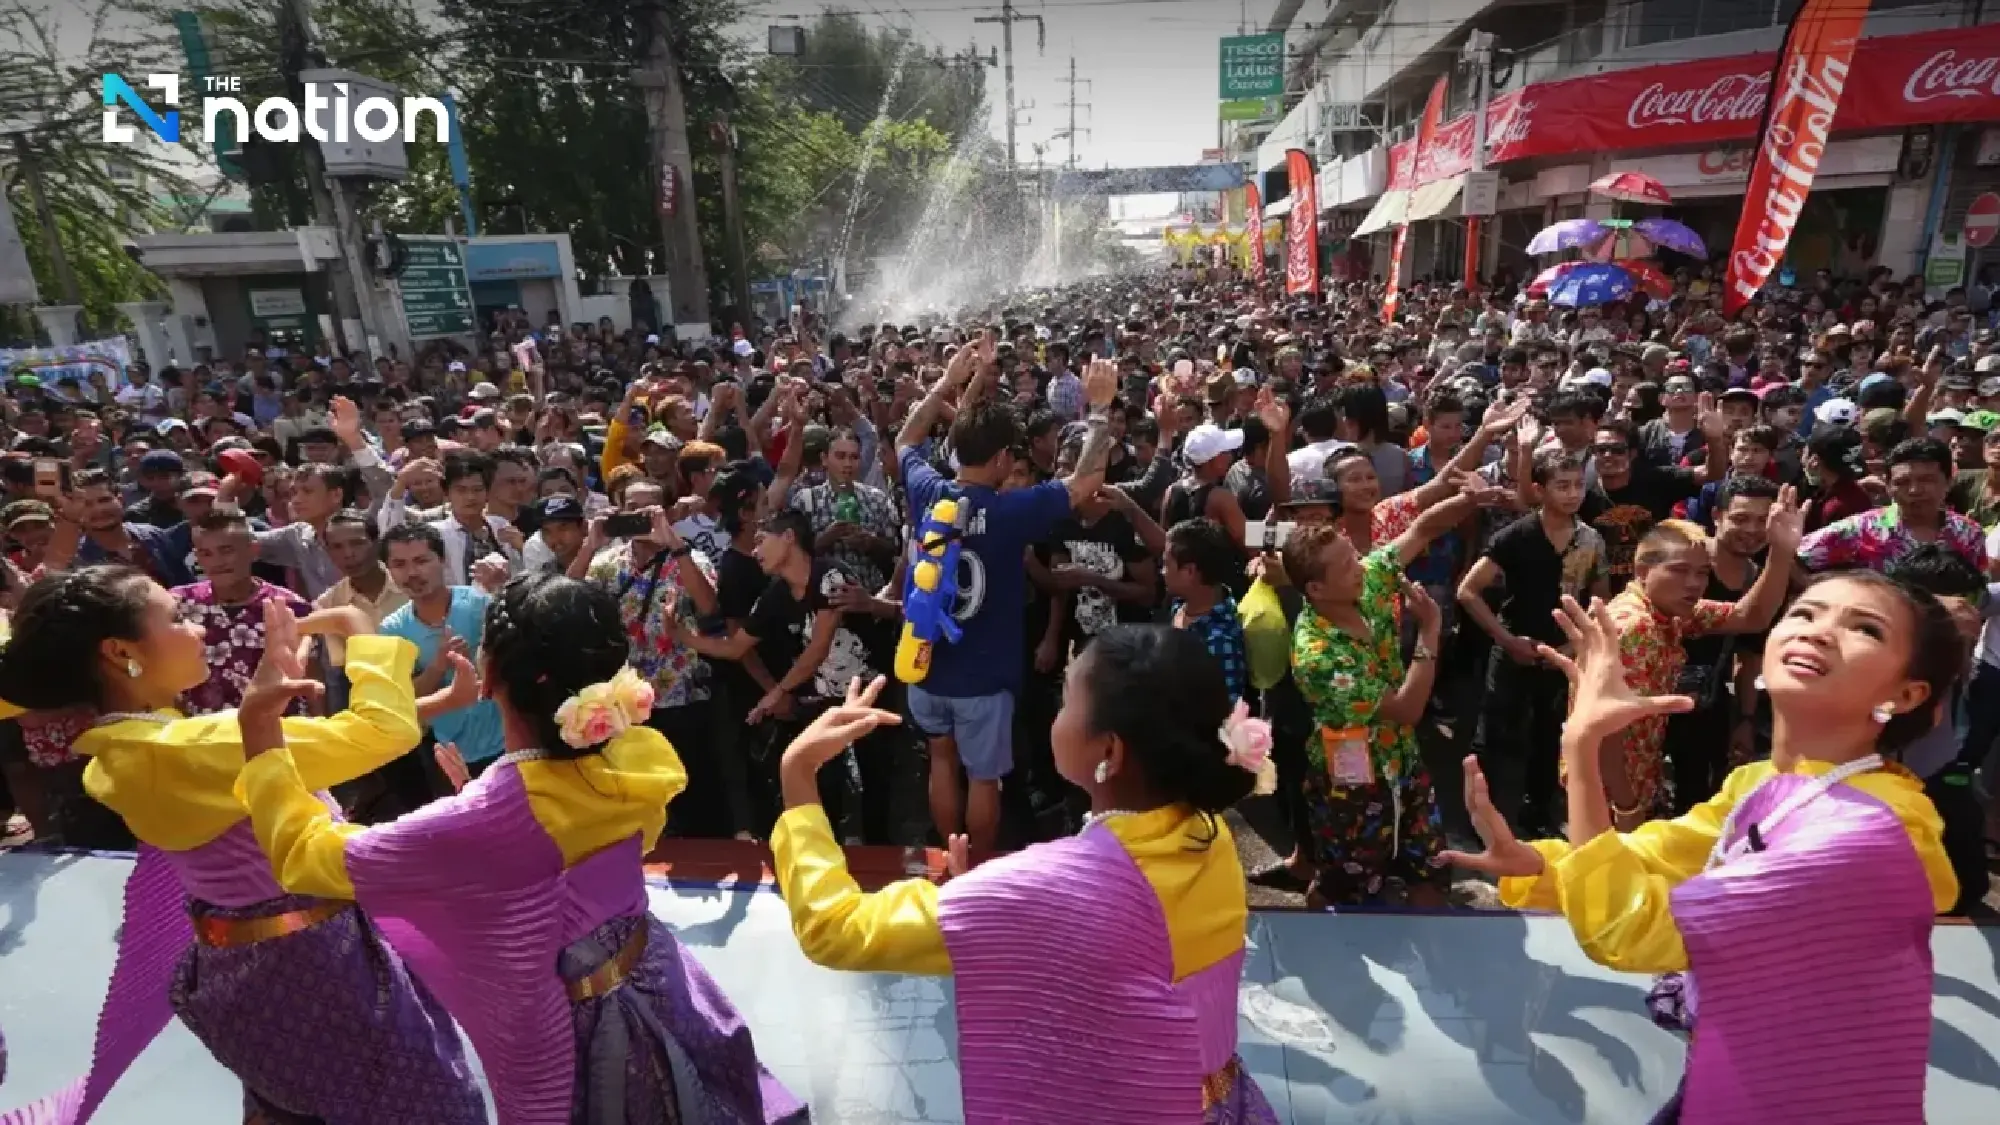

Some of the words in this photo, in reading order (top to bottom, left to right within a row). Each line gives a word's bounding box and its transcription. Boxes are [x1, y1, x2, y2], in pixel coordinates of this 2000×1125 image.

[1224, 43, 1279, 56] TESCO
[1225, 59, 1277, 77] Lotus
[1627, 71, 1772, 128] Coca-Cola
